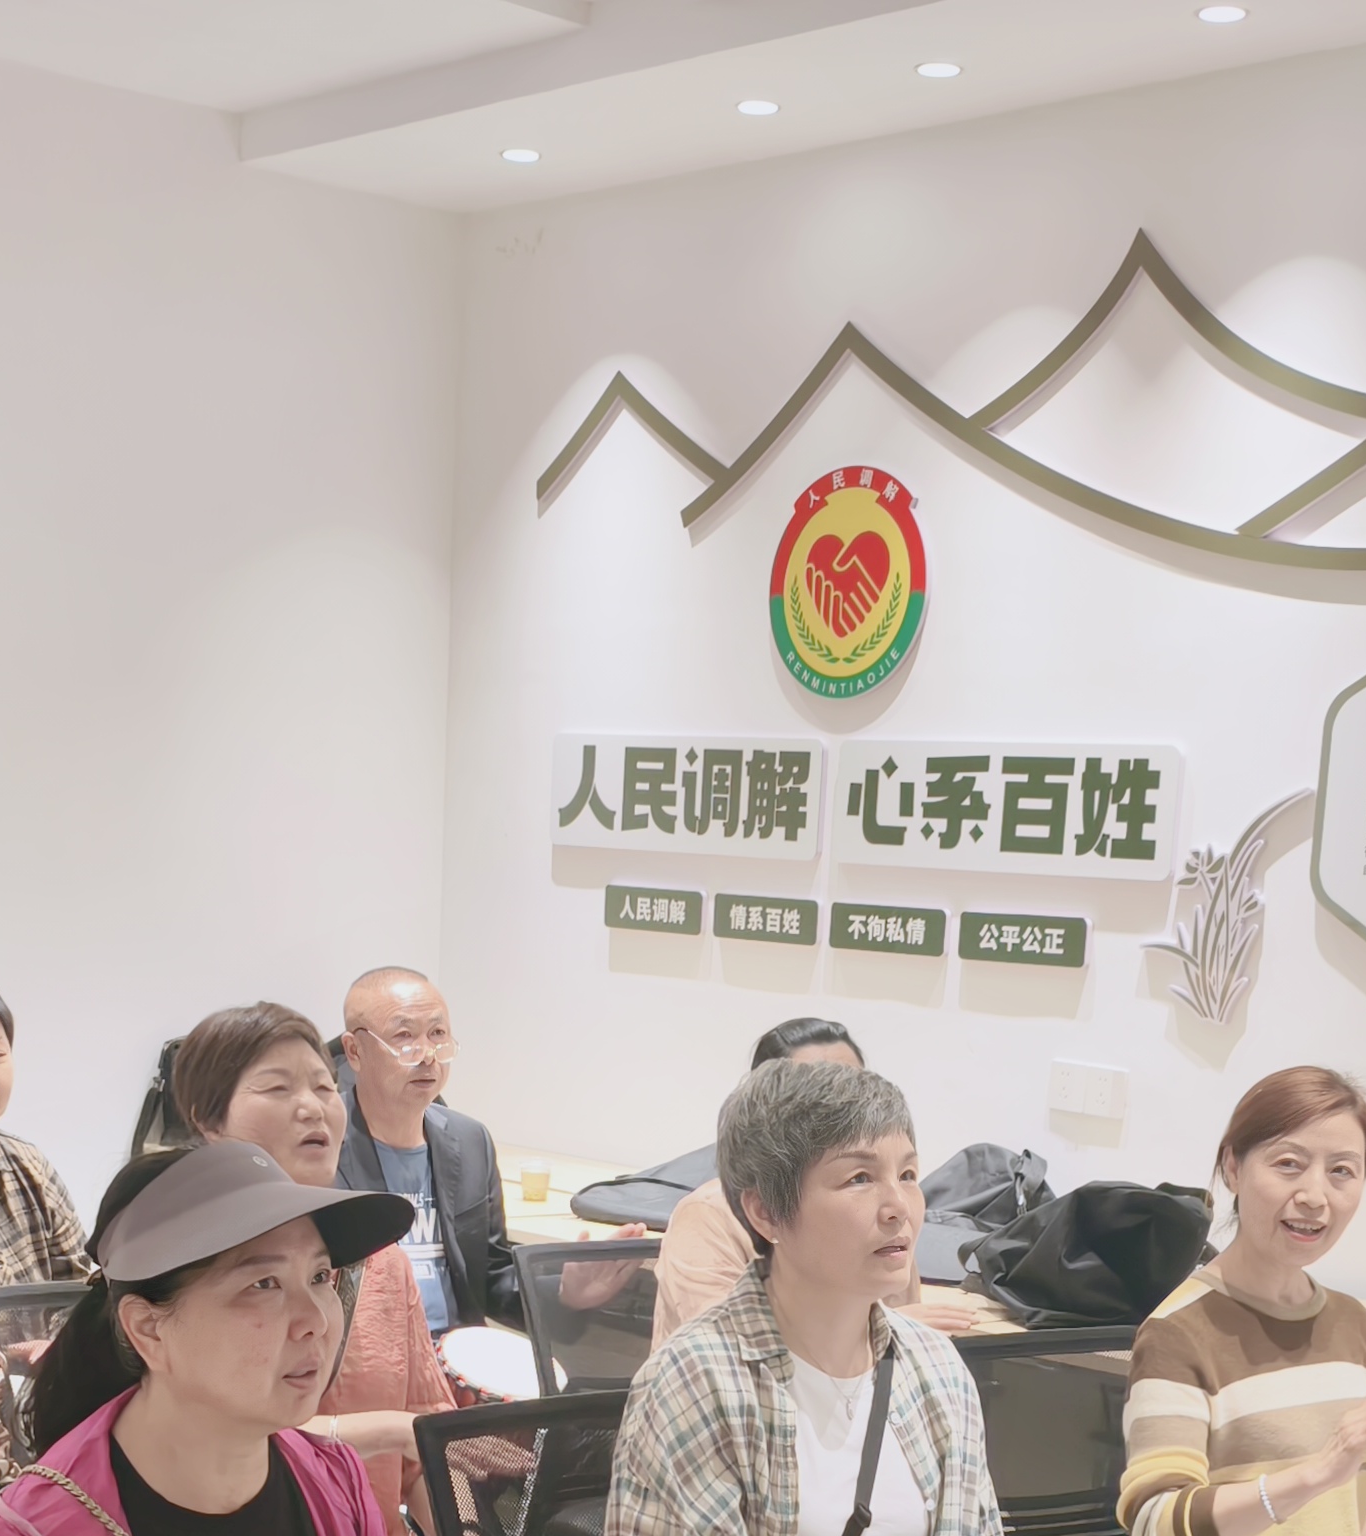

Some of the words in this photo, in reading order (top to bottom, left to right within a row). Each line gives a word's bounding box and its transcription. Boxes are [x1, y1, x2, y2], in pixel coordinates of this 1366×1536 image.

[808, 468, 900, 508] 人民调解
[786, 647, 901, 695] RENMINTIAOJIE
[557, 743, 812, 842] 人民调解
[846, 754, 1161, 861] 心系百姓
[619, 894, 687, 926] 人民调解
[729, 903, 801, 936] 情系百姓
[848, 914, 927, 946] 不徇私情
[978, 922, 1066, 956] 公平公正
